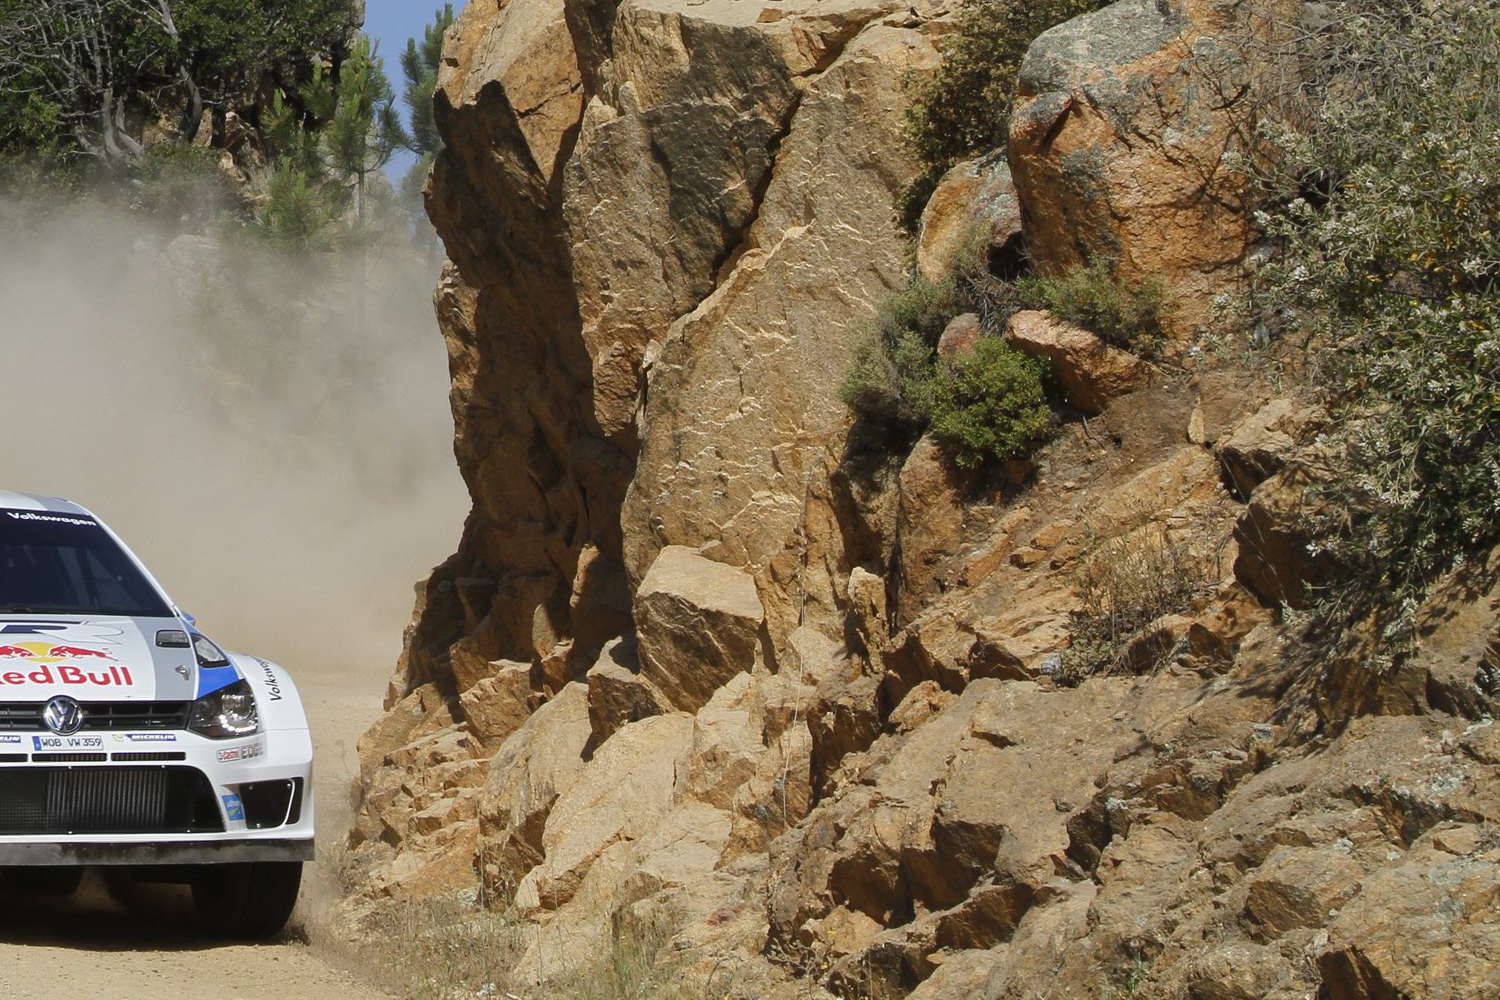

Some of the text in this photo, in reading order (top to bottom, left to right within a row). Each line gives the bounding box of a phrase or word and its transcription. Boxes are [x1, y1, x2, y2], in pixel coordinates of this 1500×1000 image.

[6, 512, 97, 526] Volkswagen
[57, 666, 134, 686] Bull
[41, 737, 101, 747] WOB VW 359
[130, 733, 175, 742] MICHELIN
